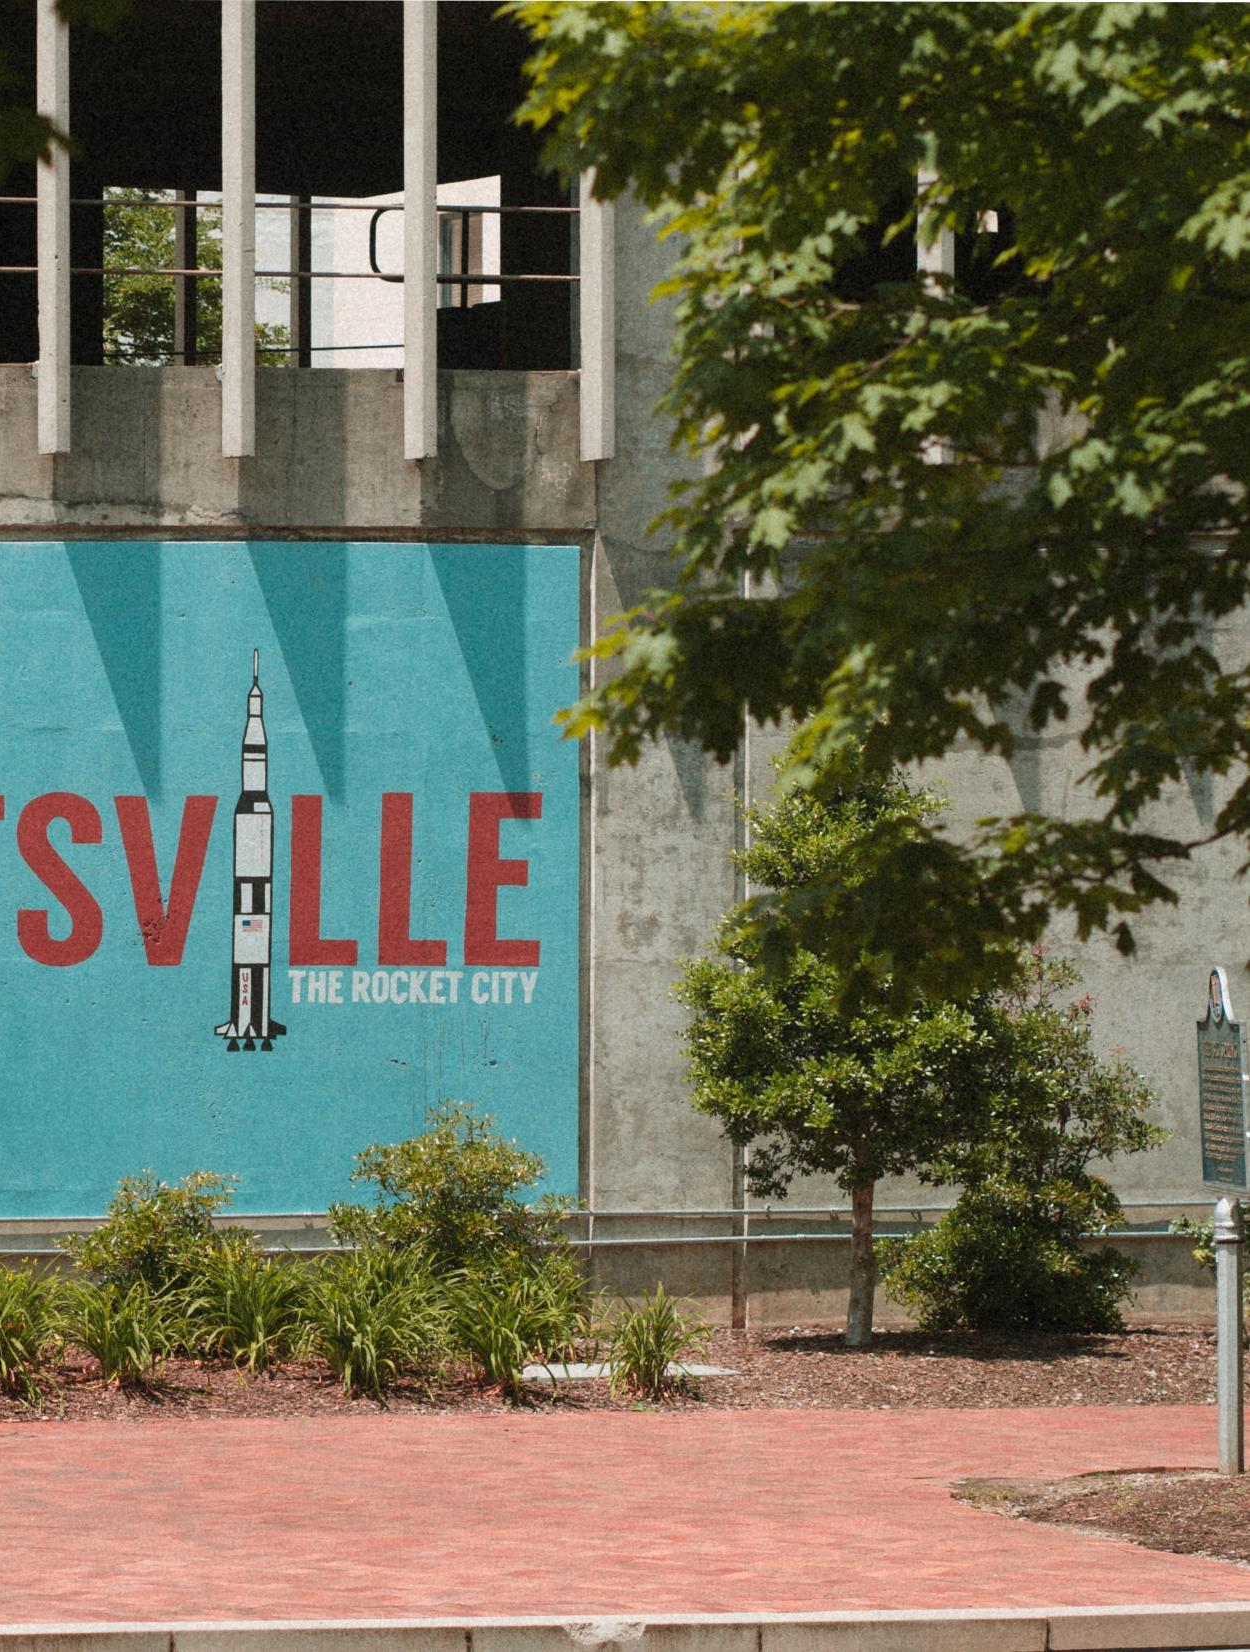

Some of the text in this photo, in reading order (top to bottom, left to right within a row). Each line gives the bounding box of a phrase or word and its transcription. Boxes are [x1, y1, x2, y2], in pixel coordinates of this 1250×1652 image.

[241, 972, 249, 1006] USA
[288, 970, 539, 1005] THE ROCKET CITY
